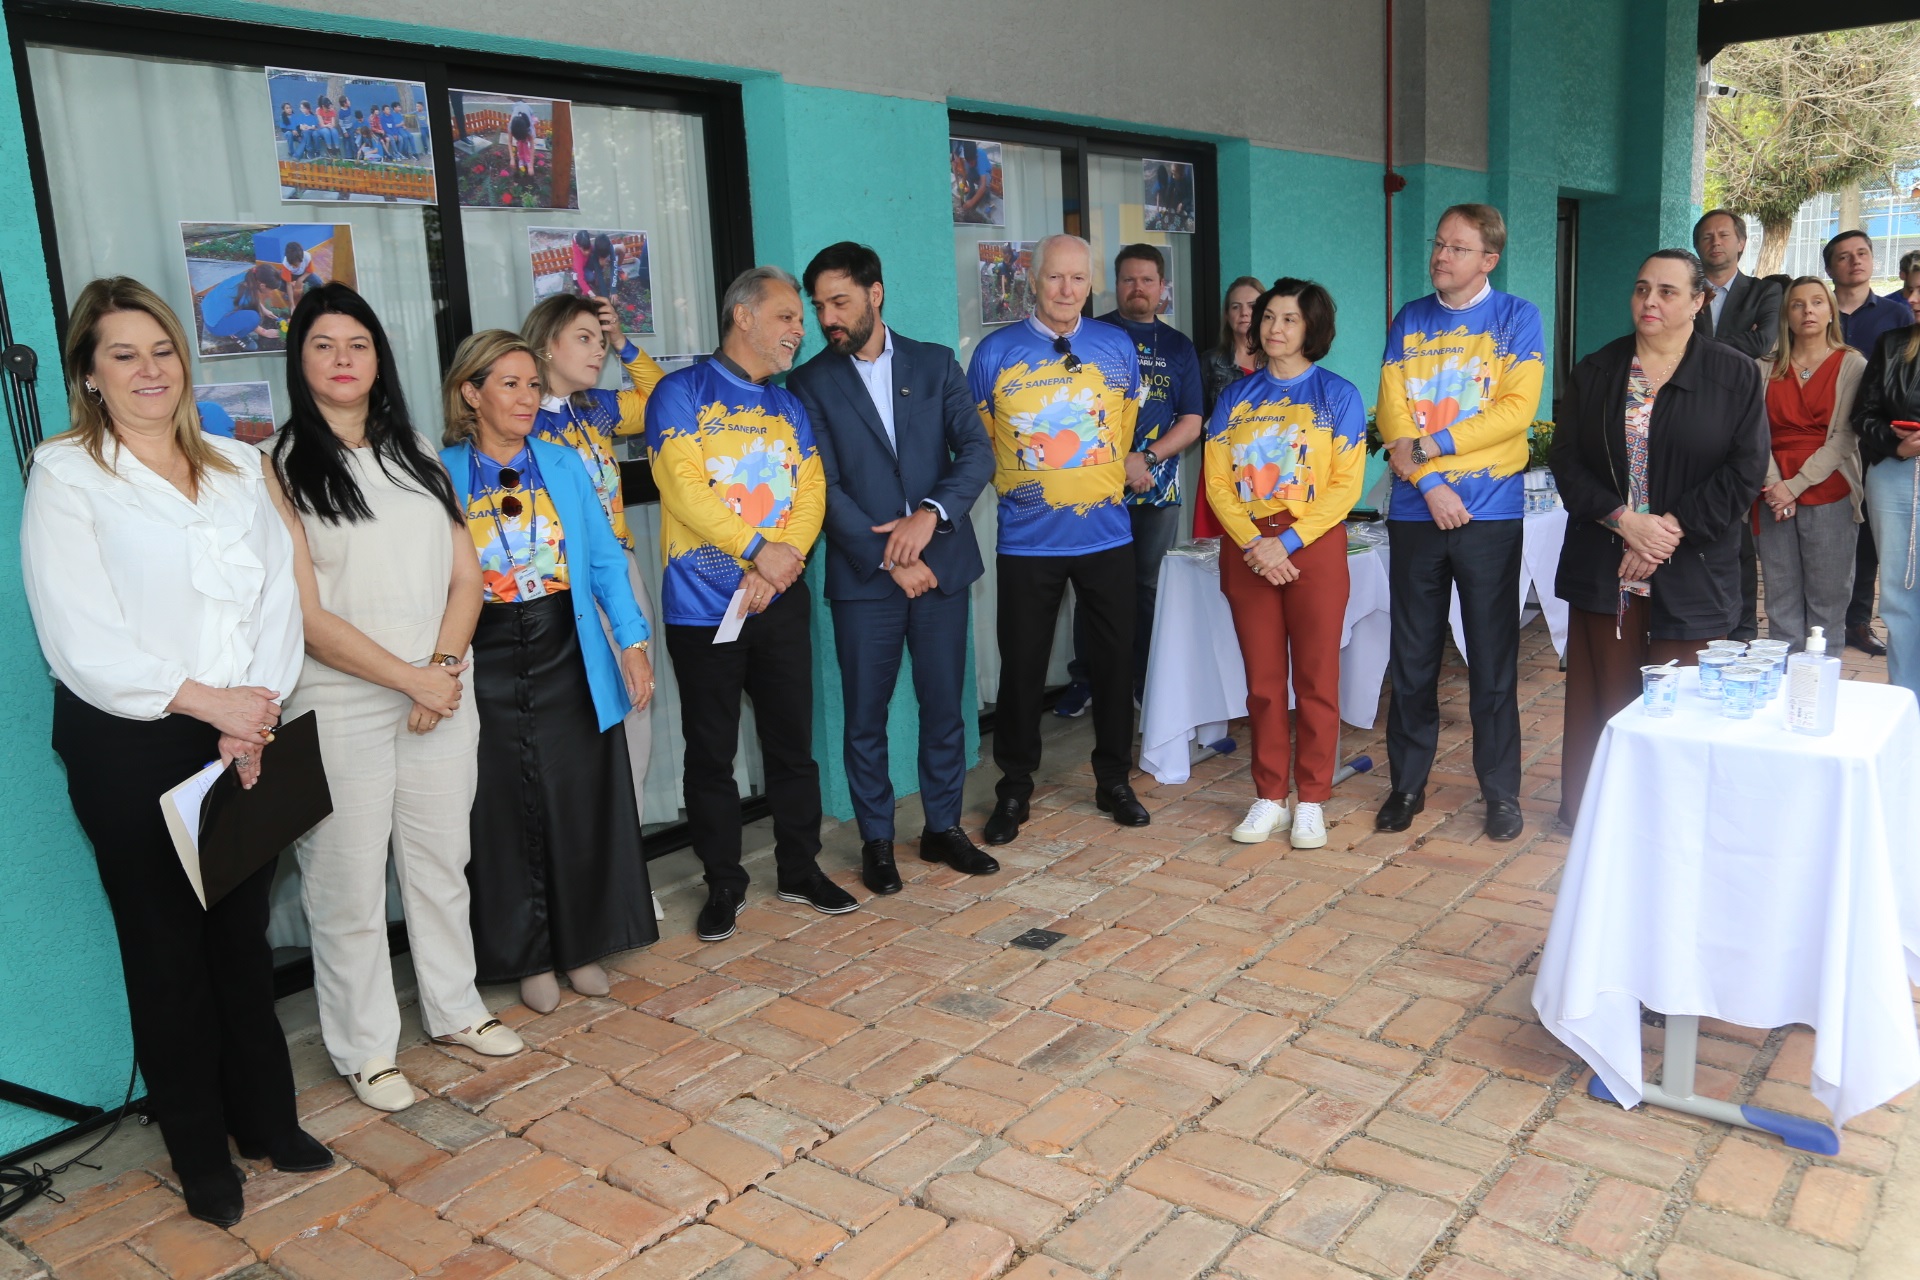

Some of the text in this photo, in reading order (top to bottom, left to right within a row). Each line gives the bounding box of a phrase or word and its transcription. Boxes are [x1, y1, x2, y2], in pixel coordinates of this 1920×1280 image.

[1420, 346, 1464, 357] SANEPAR
[1025, 376, 1074, 389] SANEPAR
[1243, 415, 1286, 424] SANEPAR
[727, 423, 767, 434] SANEPAR
